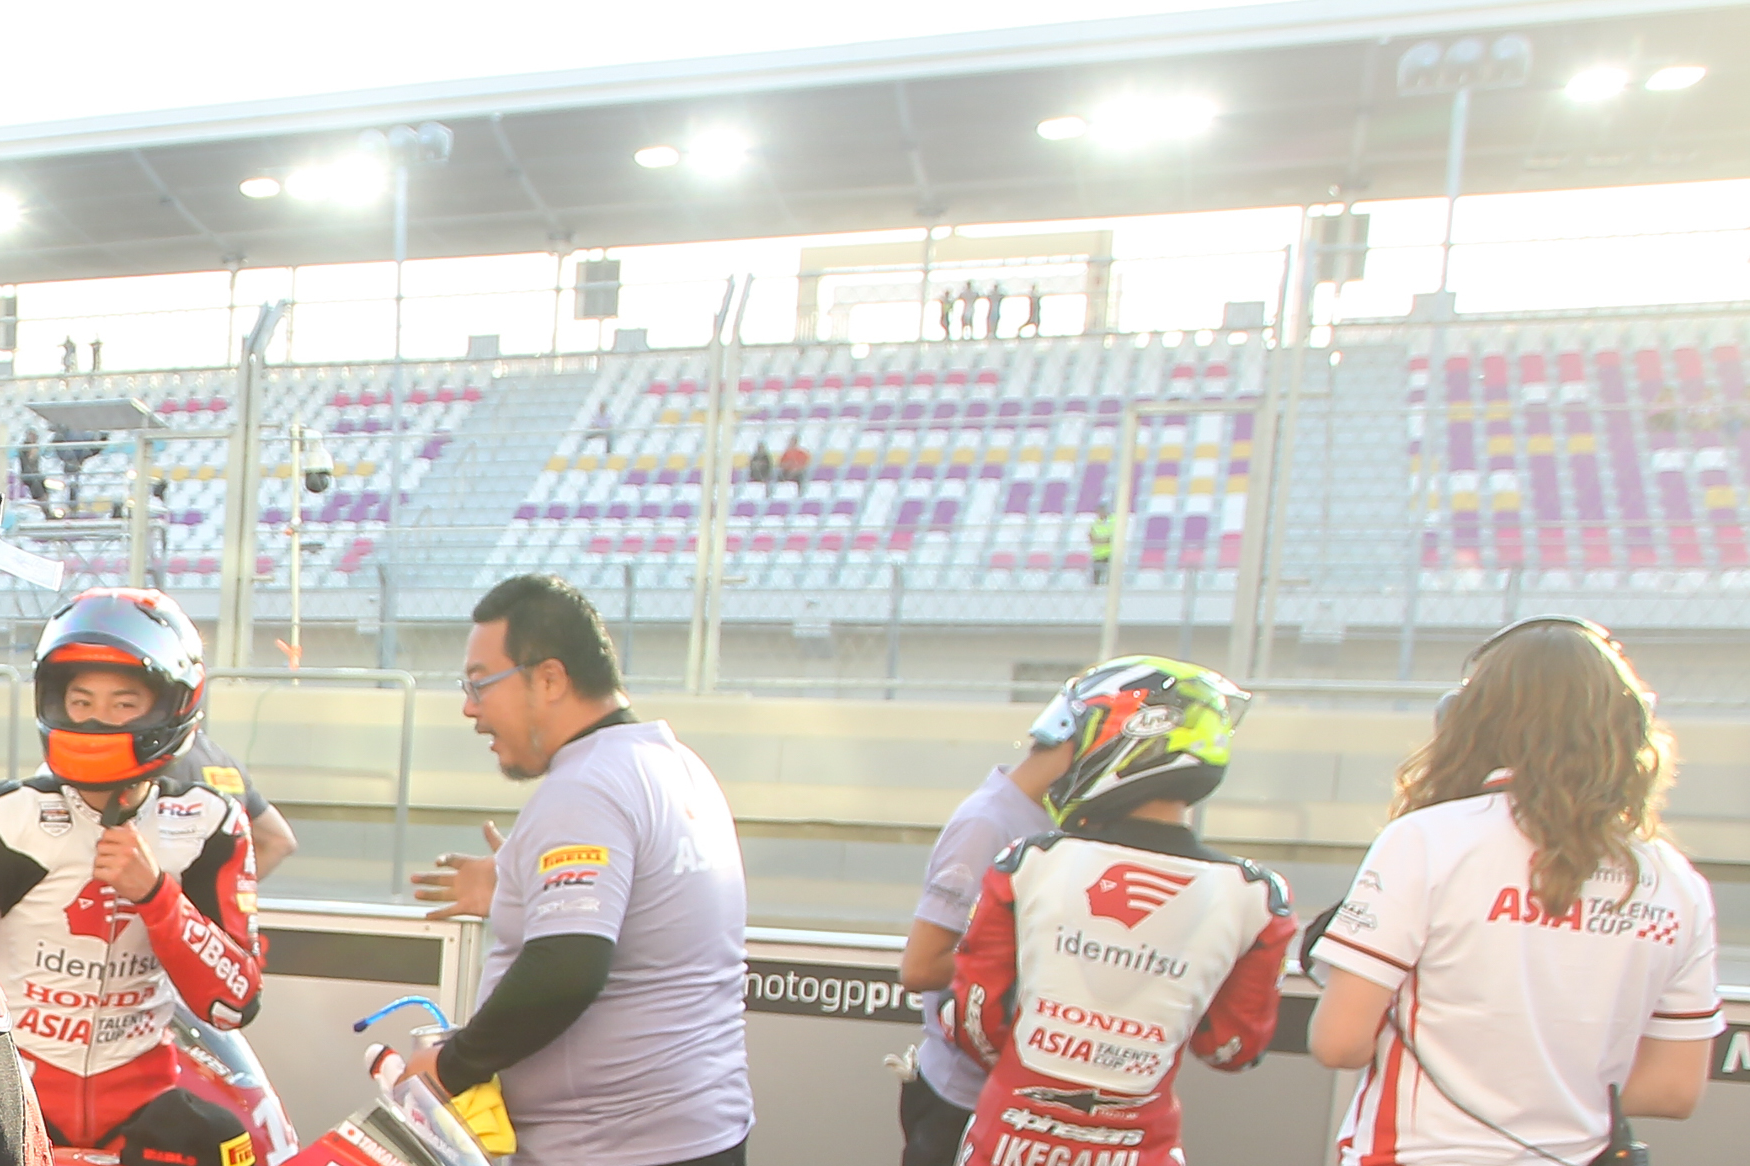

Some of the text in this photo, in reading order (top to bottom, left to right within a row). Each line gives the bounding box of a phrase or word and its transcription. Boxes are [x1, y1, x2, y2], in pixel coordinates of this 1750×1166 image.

[1487, 886, 1582, 932] ASA
[1586, 915, 1634, 936] CUP
[199, 935, 251, 1000] Beta
[1055, 926, 1189, 979] idemitsu
[23, 980, 156, 1009] HONDA
[16, 1006, 93, 1046] ASIA
[96, 1029, 125, 1043] CUP
[1035, 997, 1166, 1043] HONDA
[1028, 1025, 1093, 1064] ASIA
